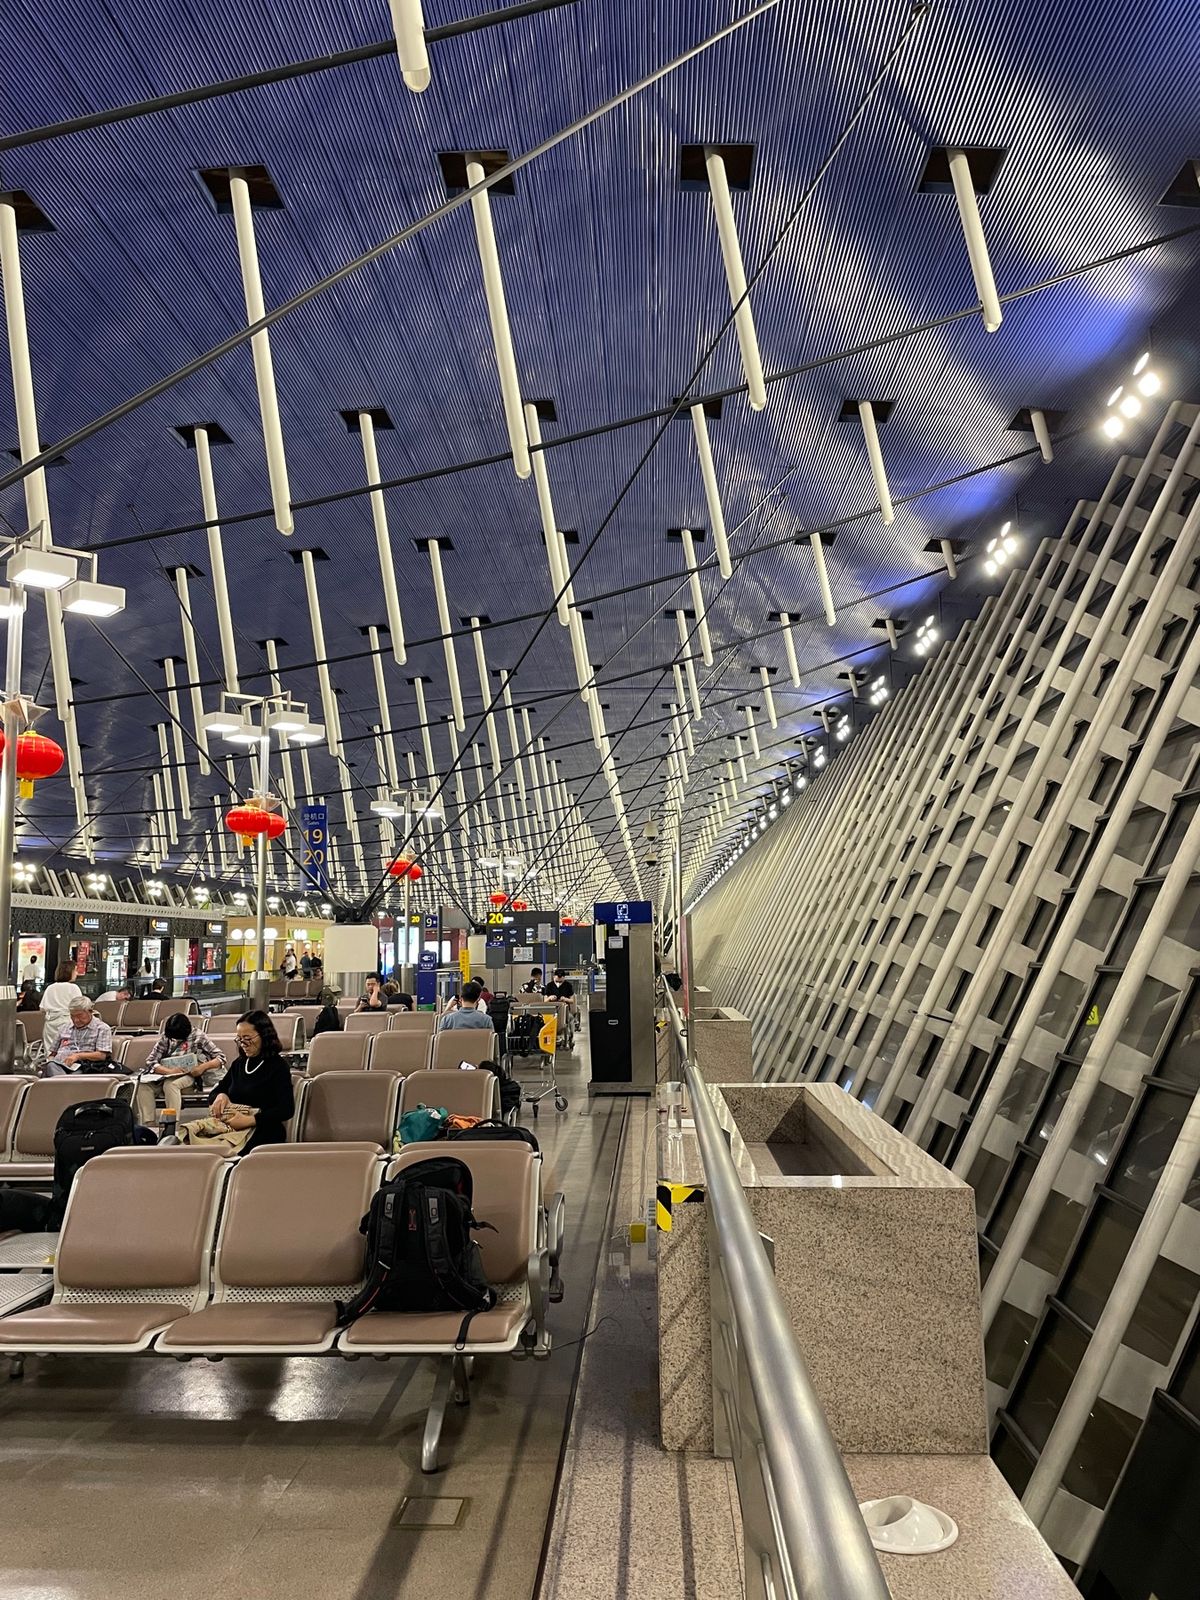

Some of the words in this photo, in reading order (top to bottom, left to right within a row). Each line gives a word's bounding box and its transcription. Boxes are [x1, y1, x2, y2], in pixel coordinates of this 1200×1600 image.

[303, 829, 323, 844] 19
[303, 849, 324, 865] 20
[411, 915, 420, 923] 20
[488, 913, 503, 924] 20
